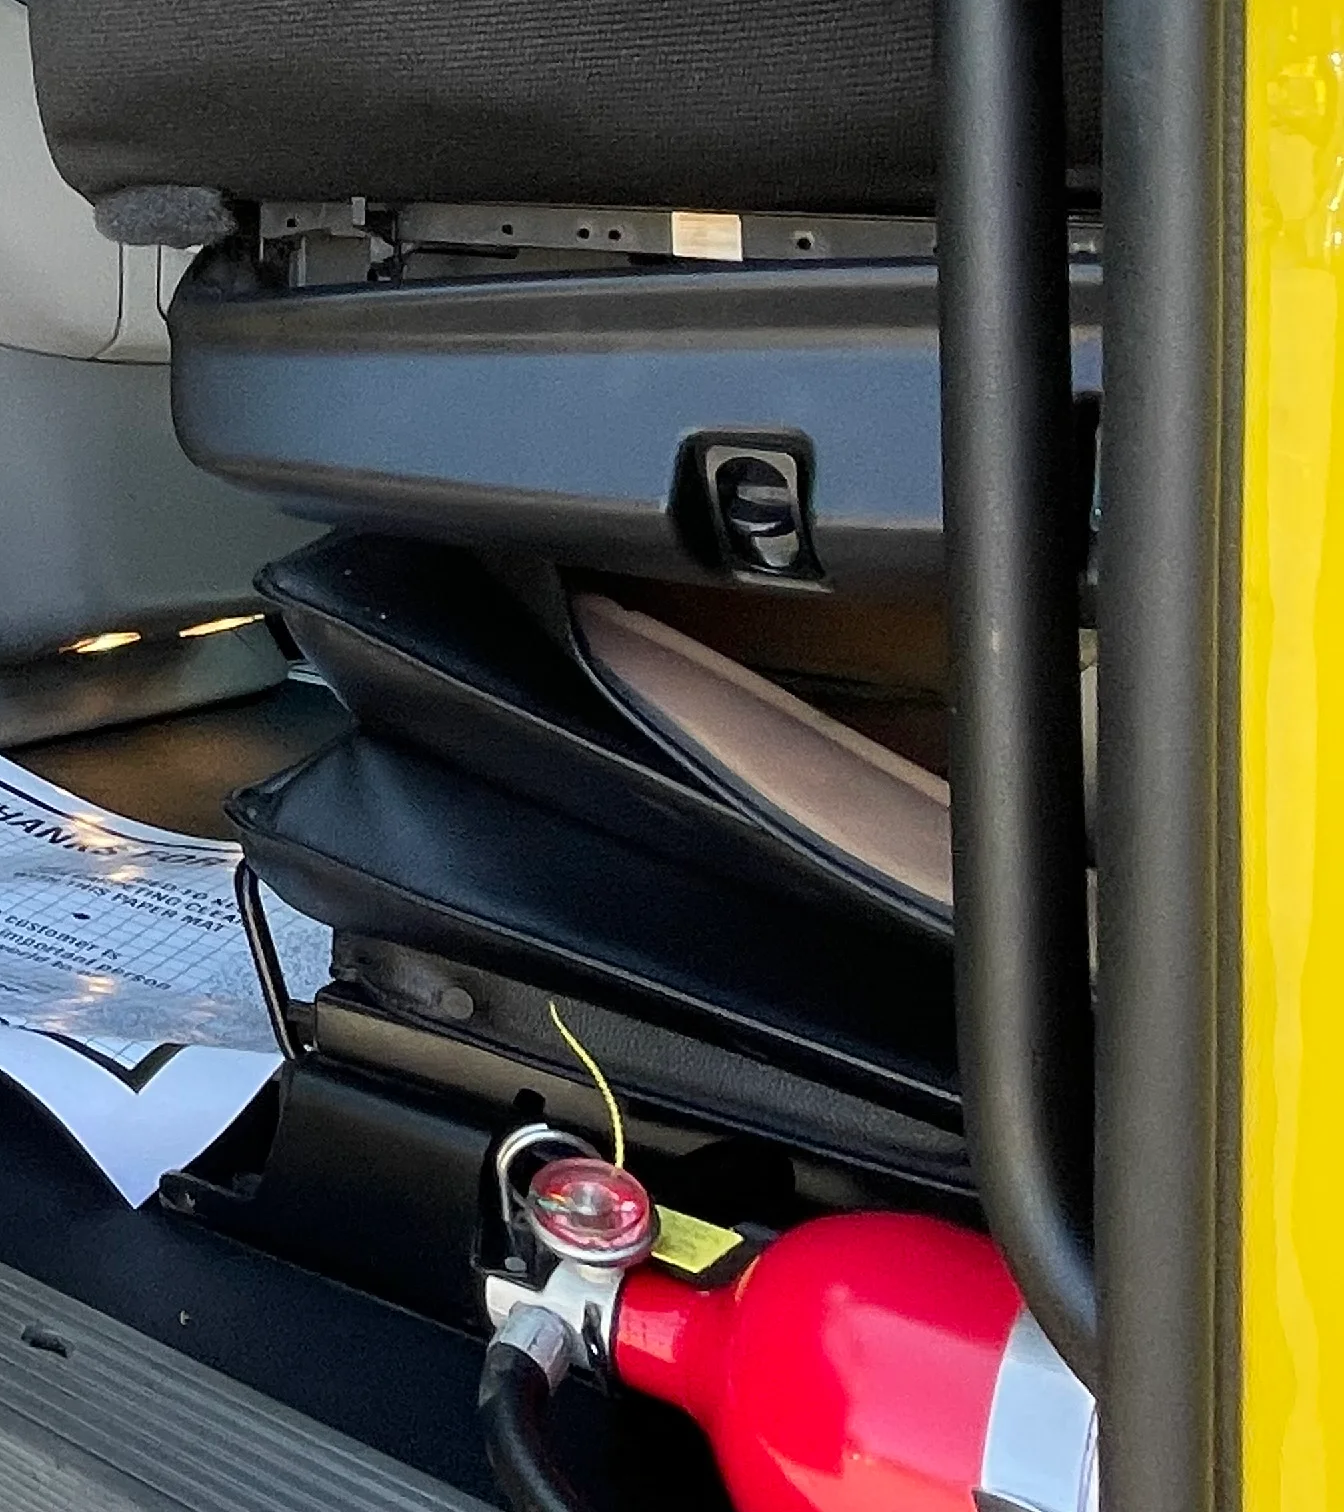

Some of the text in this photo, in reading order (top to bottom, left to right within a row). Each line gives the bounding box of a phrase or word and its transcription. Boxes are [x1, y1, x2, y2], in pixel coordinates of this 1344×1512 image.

[111, 892, 178, 918] PAPER
[180, 914, 225, 933] MAT
[4, 914, 99, 952] customer
[95, 963, 172, 990] person
